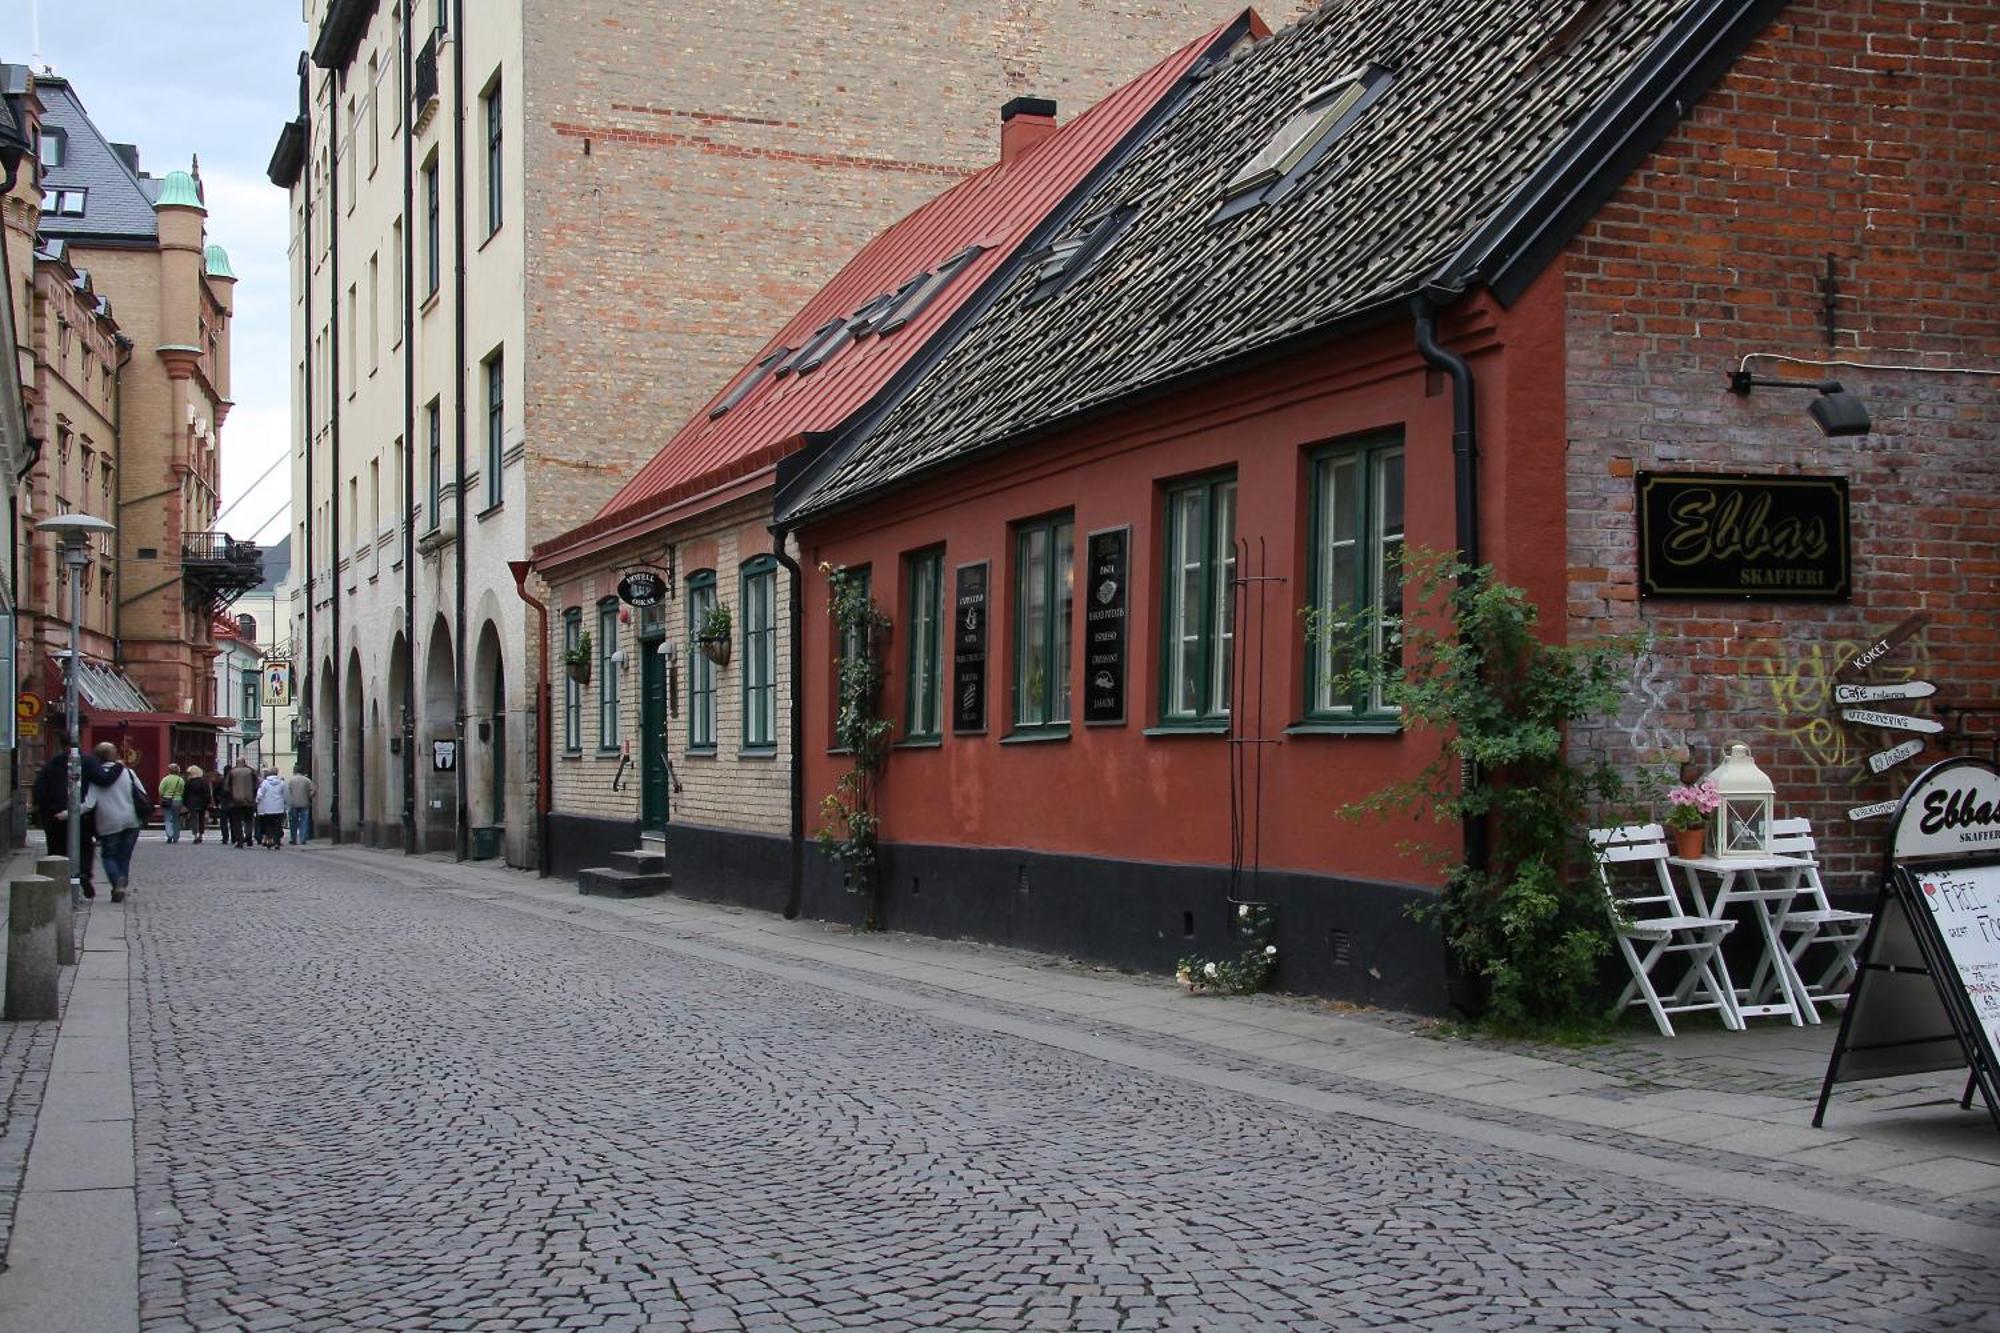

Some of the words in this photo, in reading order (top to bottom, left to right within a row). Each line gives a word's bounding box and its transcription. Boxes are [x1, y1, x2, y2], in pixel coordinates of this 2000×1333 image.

[1662, 488, 1828, 566] Ebbas
[1740, 567, 1824, 585] SKAFFERI
[1852, 639, 1891, 670] KÖKET
[1838, 686, 1868, 700] Café
